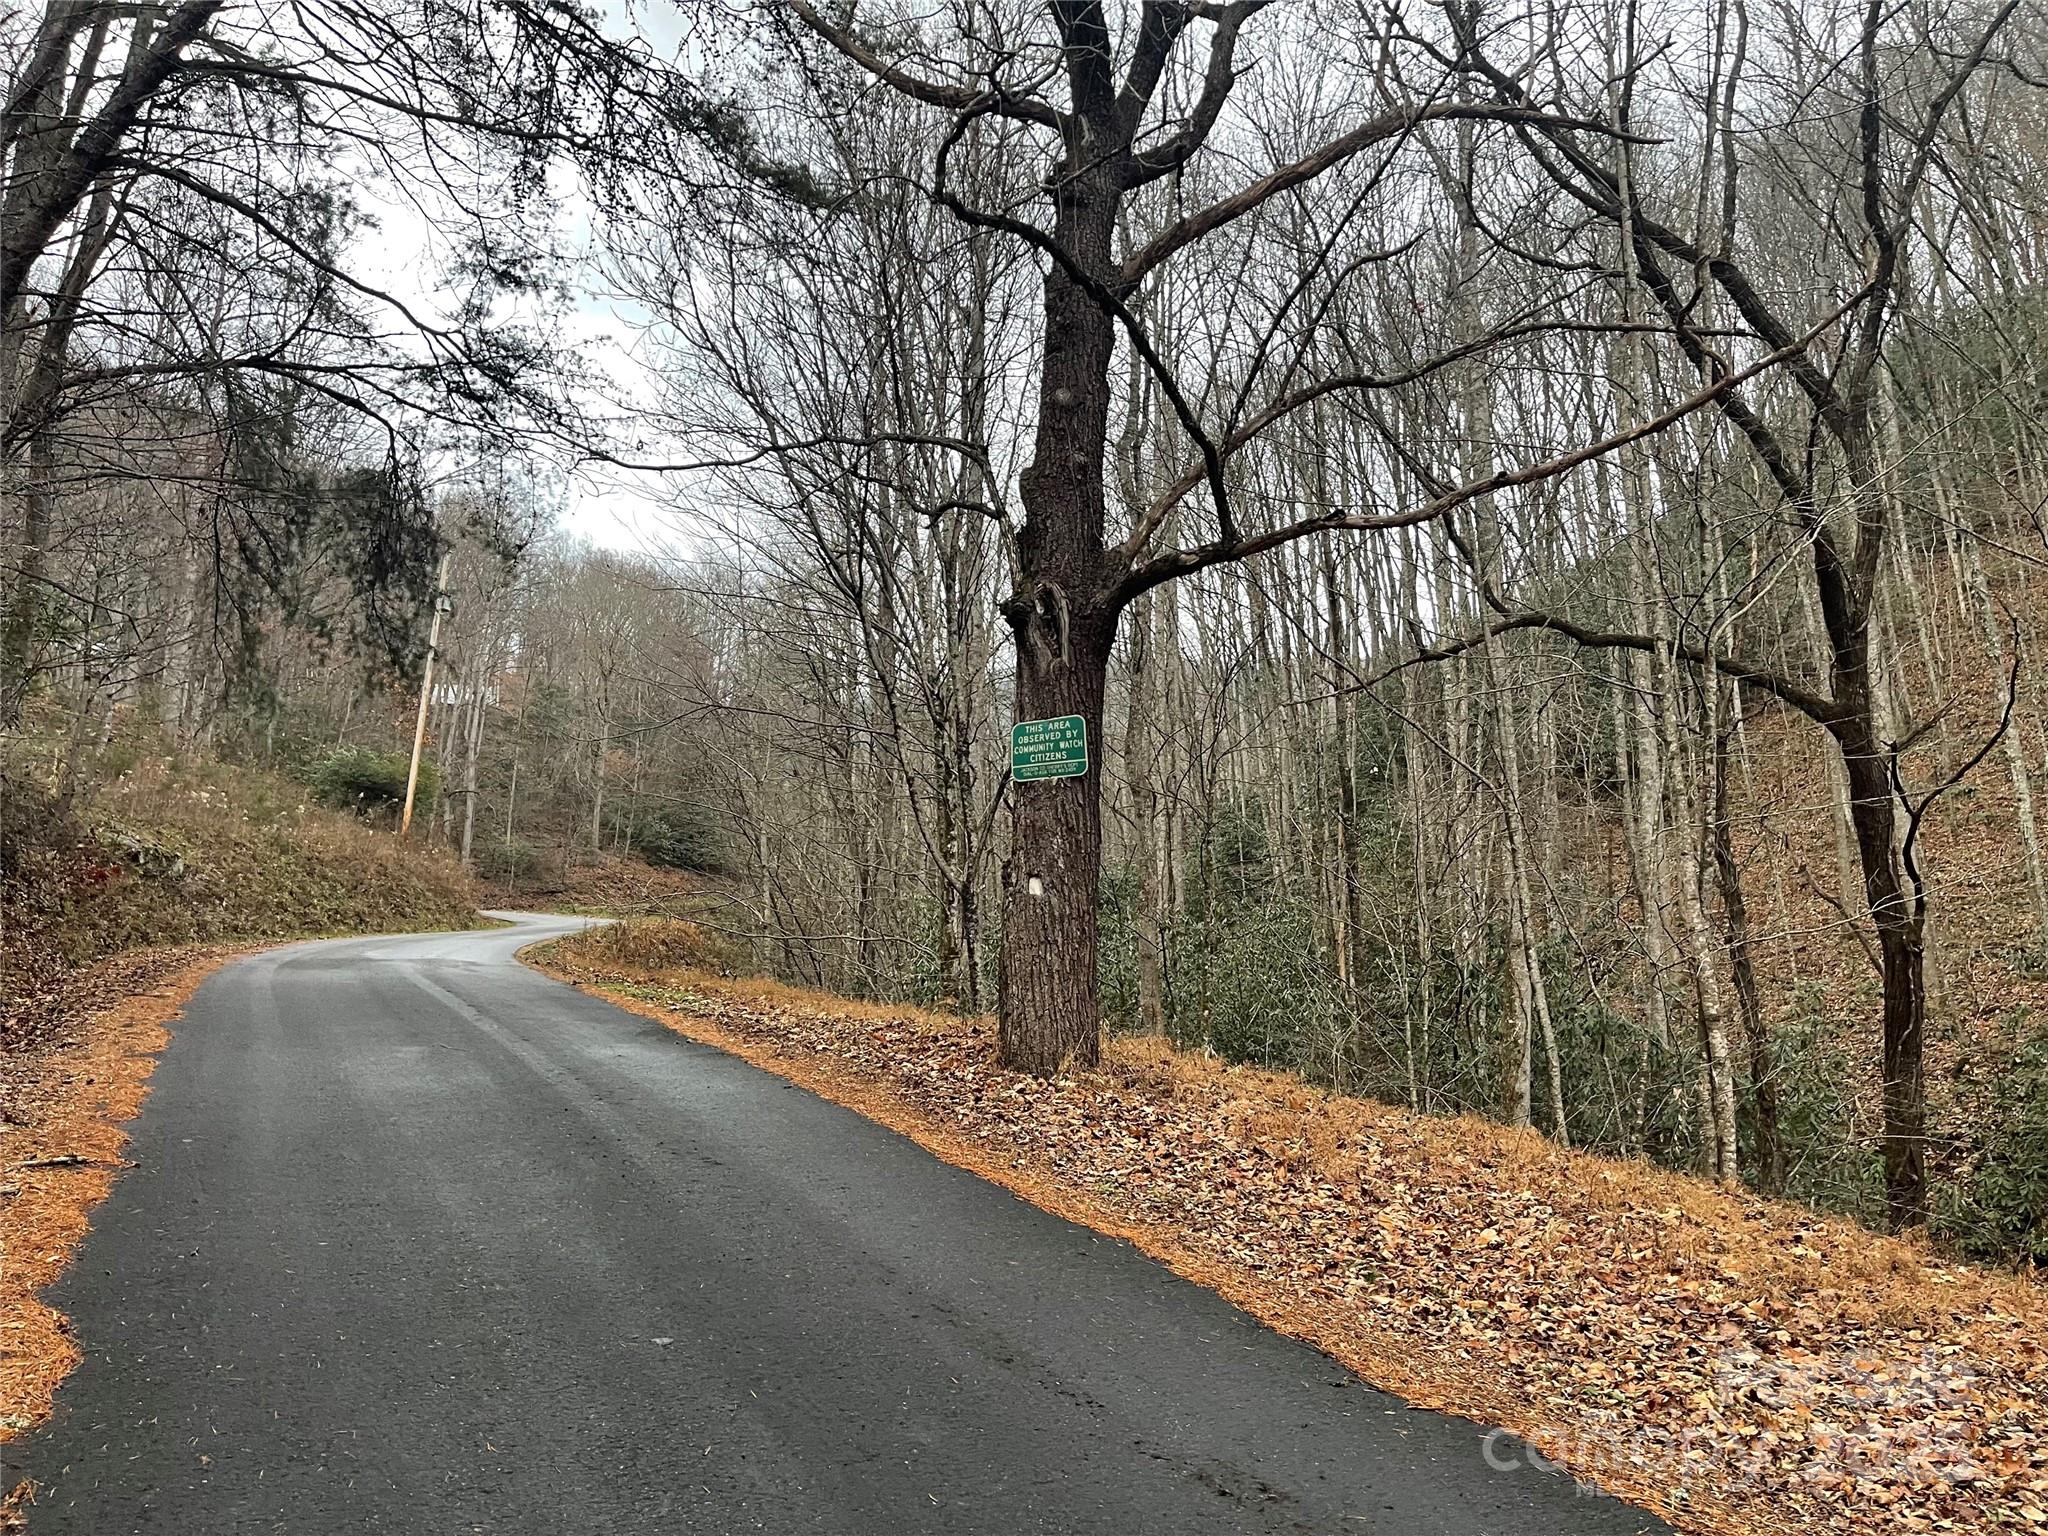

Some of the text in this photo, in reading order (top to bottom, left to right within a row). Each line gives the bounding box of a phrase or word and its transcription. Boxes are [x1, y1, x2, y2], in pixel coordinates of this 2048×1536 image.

[1025, 720, 1071, 733] THIS AREA
[1018, 729, 1078, 744] OBSERVED BY
[1014, 739, 1083, 755] COMMUNITY WATCH
[1030, 751, 1067, 762] CITIZENS
